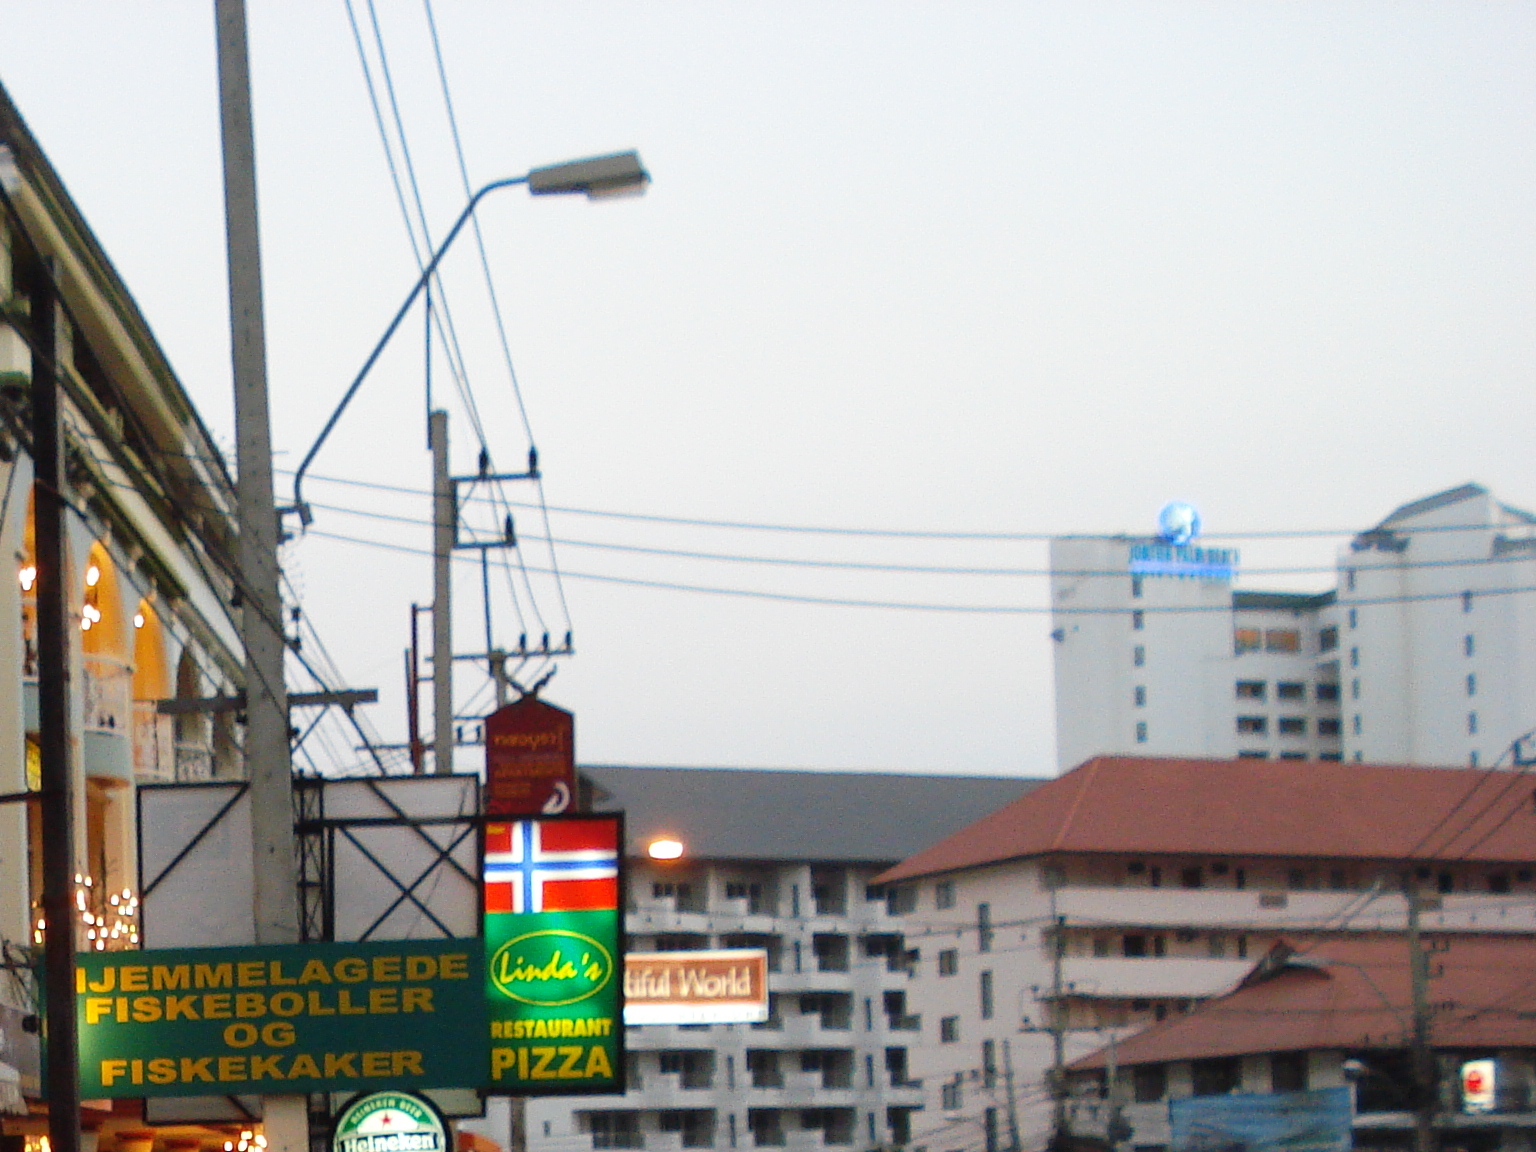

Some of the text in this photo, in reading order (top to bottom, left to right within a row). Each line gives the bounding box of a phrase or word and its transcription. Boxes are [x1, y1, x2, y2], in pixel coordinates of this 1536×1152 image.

[498, 950, 603, 983] Linda's
[678, 965, 751, 998] World
[86, 987, 435, 1025] FISKEBOLLER
[223, 1021, 296, 1048] OG
[490, 1018, 613, 1039] RESTAURANT
[101, 1050, 426, 1086] FISKEKAKER
[491, 1046, 613, 1081] PIZZA
